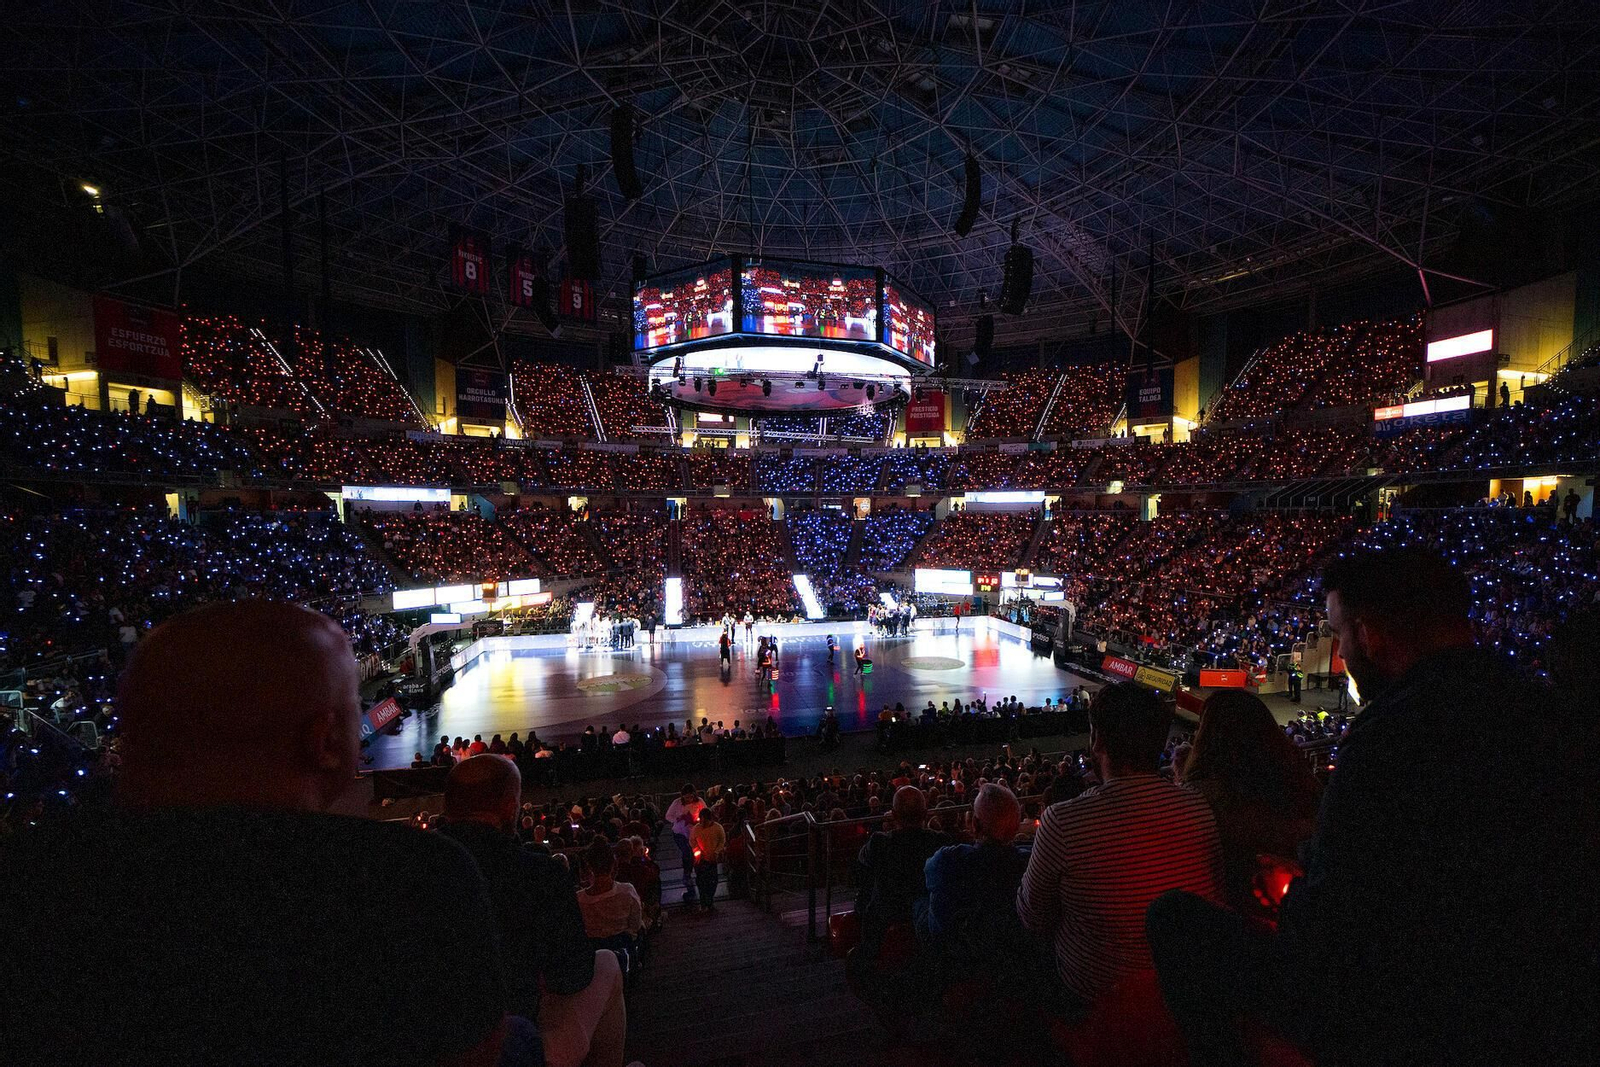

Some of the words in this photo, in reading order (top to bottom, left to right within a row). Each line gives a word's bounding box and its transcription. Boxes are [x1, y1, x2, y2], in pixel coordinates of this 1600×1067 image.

[465, 261, 477, 280] 8
[522, 279, 533, 297] 5
[572, 293, 582, 309] 9
[110, 327, 166, 347] ESFUERZO
[108, 338, 171, 358] ESFORTZUA
[1139, 387, 1161, 395] EQUIPO
[1108, 661, 1133, 675] AMBAR
[376, 703, 399, 723] AMBAR
